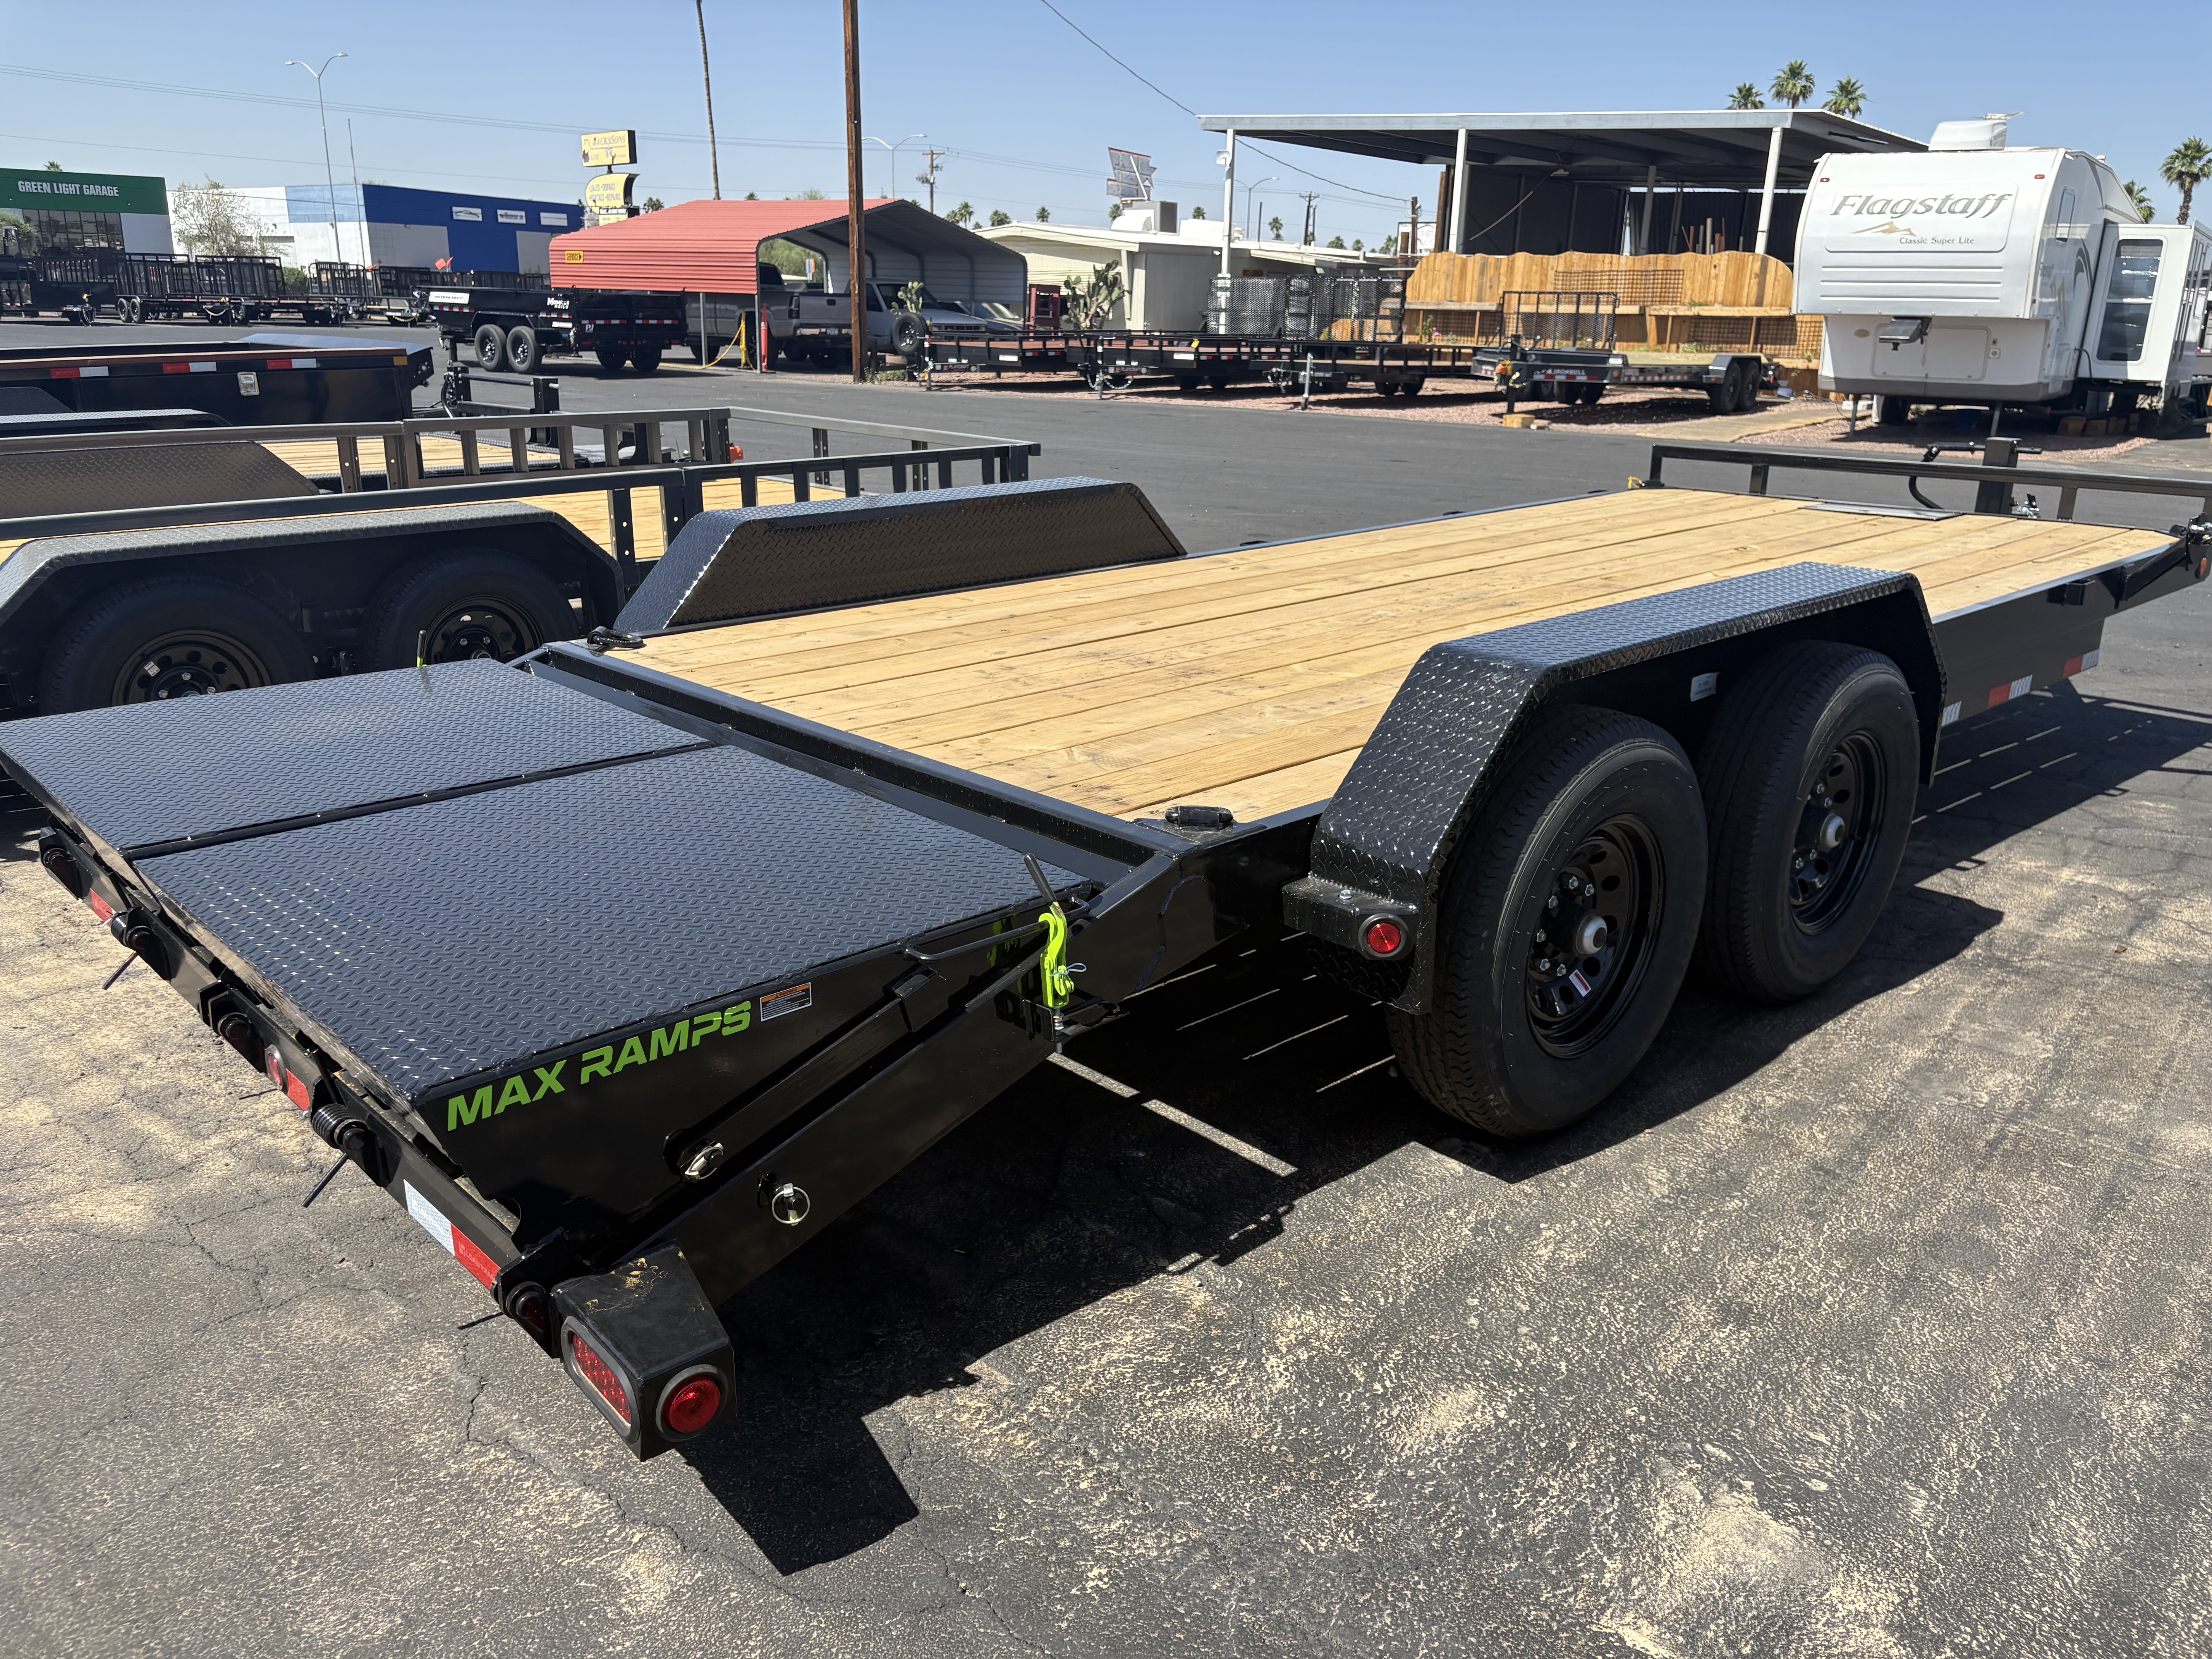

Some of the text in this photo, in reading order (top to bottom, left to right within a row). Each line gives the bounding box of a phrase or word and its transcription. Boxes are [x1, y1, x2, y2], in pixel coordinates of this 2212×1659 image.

[18, 181, 119, 197] GREEN LIGHT GARAGE
[1830, 193, 2013, 219] Flagstaff
[1931, 237, 1955, 246] Super
[1958, 236, 1975, 244] Lite
[448, 1000, 751, 1131] MAX RAMPS
